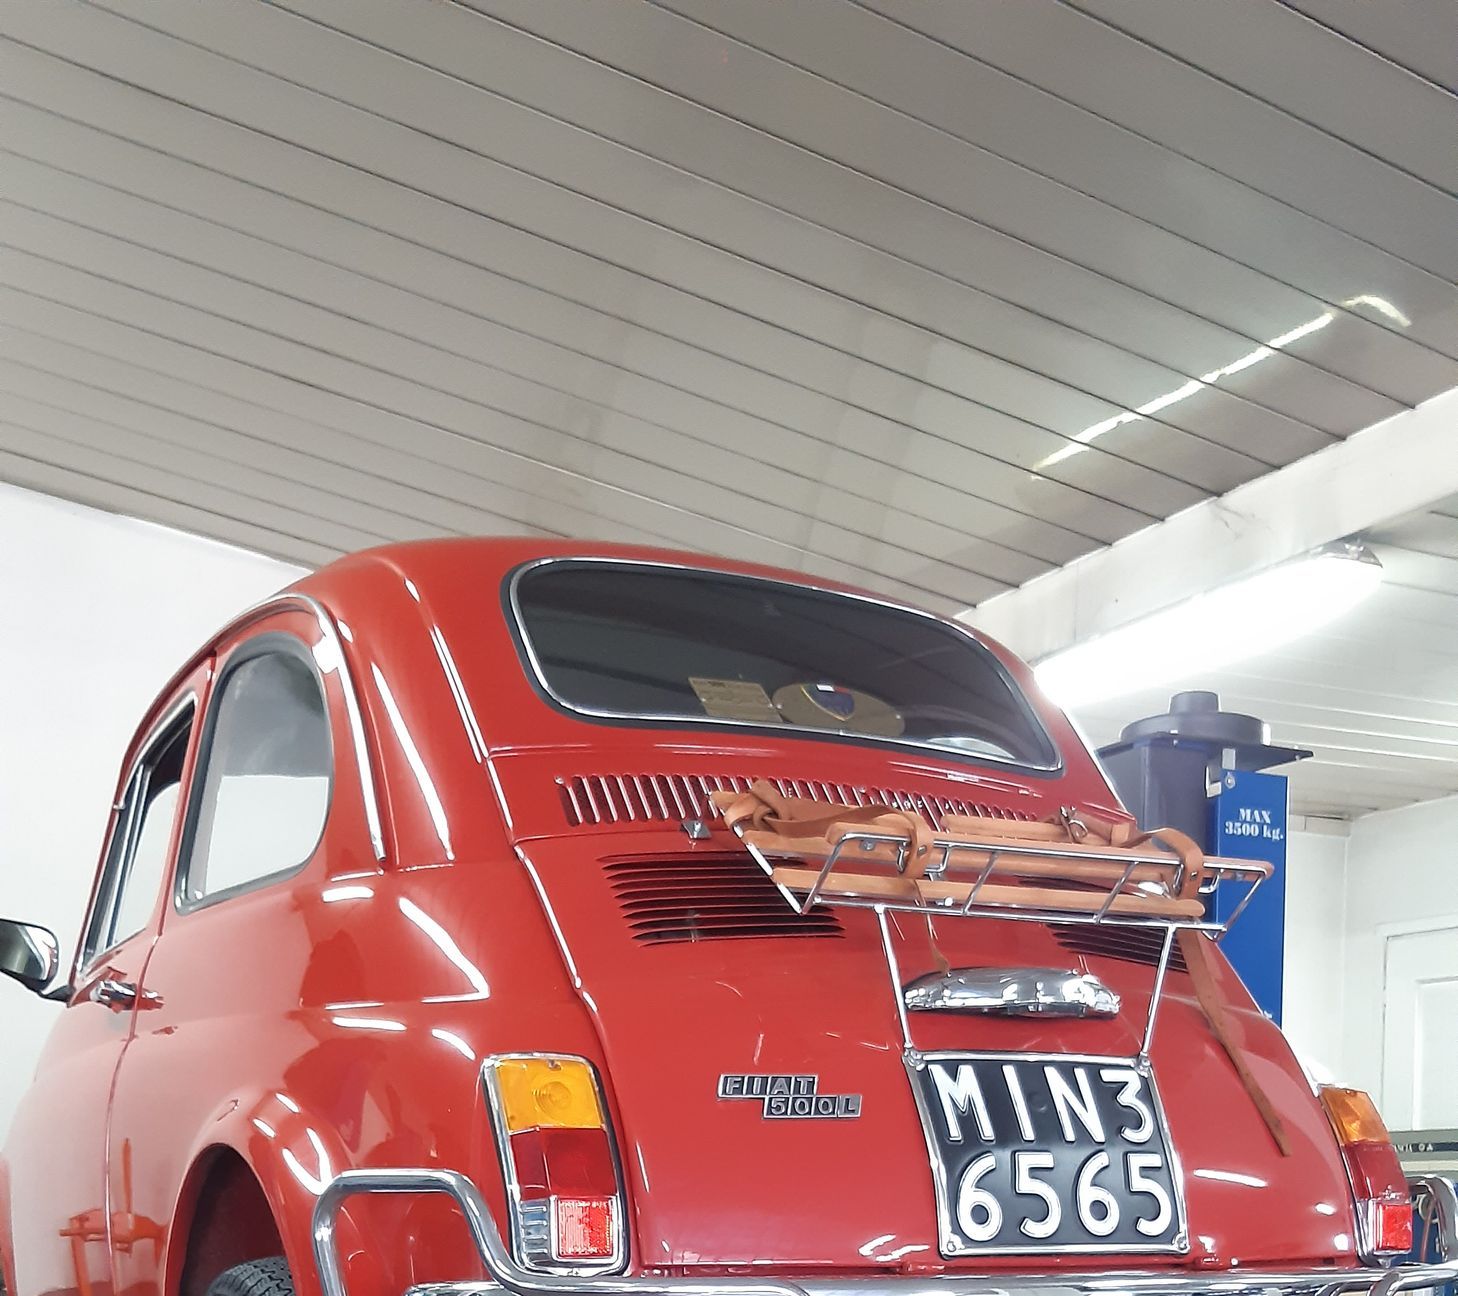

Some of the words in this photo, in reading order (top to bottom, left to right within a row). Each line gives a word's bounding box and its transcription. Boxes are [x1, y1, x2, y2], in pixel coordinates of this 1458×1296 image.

[1239, 808, 1272, 823] MAX
[1225, 821, 1259, 837] 3500
[1263, 824, 1284, 841] kg.
[726, 1077, 813, 1095] FIAT
[957, 1151, 1172, 1242] 6565
